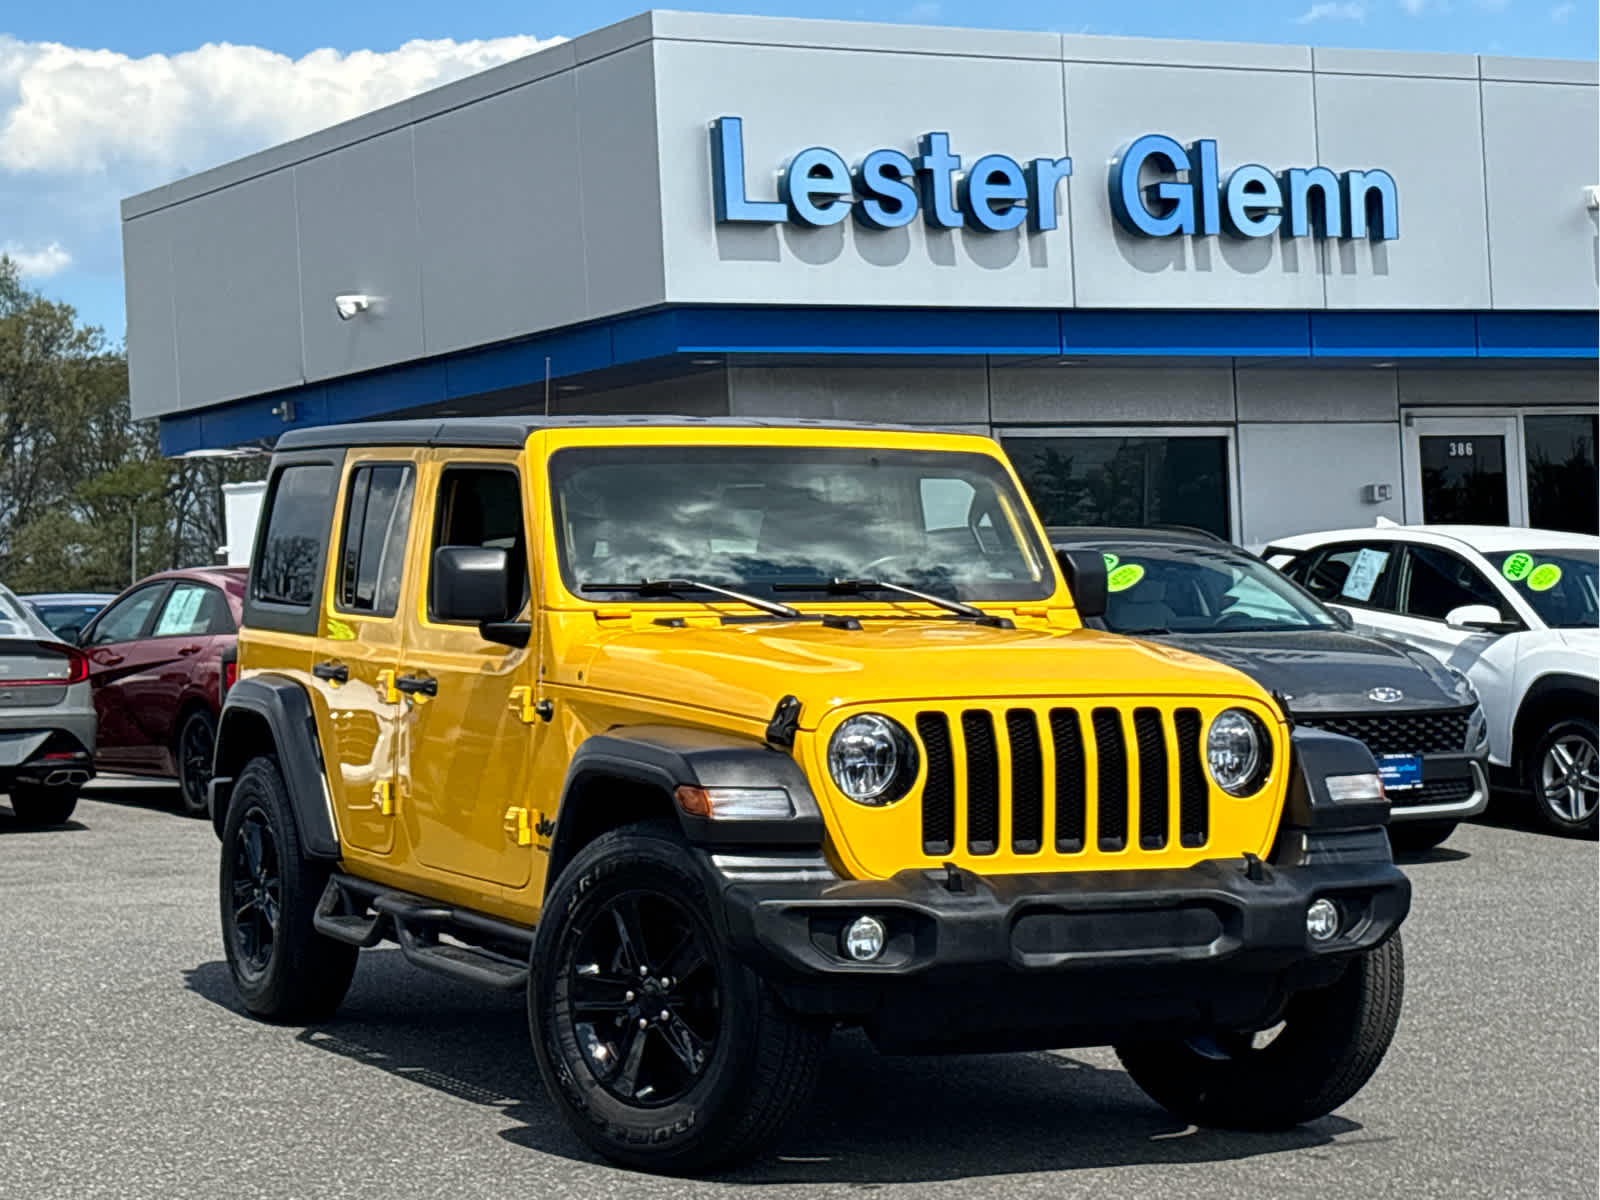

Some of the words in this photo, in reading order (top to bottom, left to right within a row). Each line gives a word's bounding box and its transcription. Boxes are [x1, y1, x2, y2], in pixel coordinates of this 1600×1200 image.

[710, 116, 1072, 231] Lester
[1109, 134, 1399, 241] Glenn
[1449, 442, 1473, 456] 386
[1507, 554, 1529, 578] 2023
